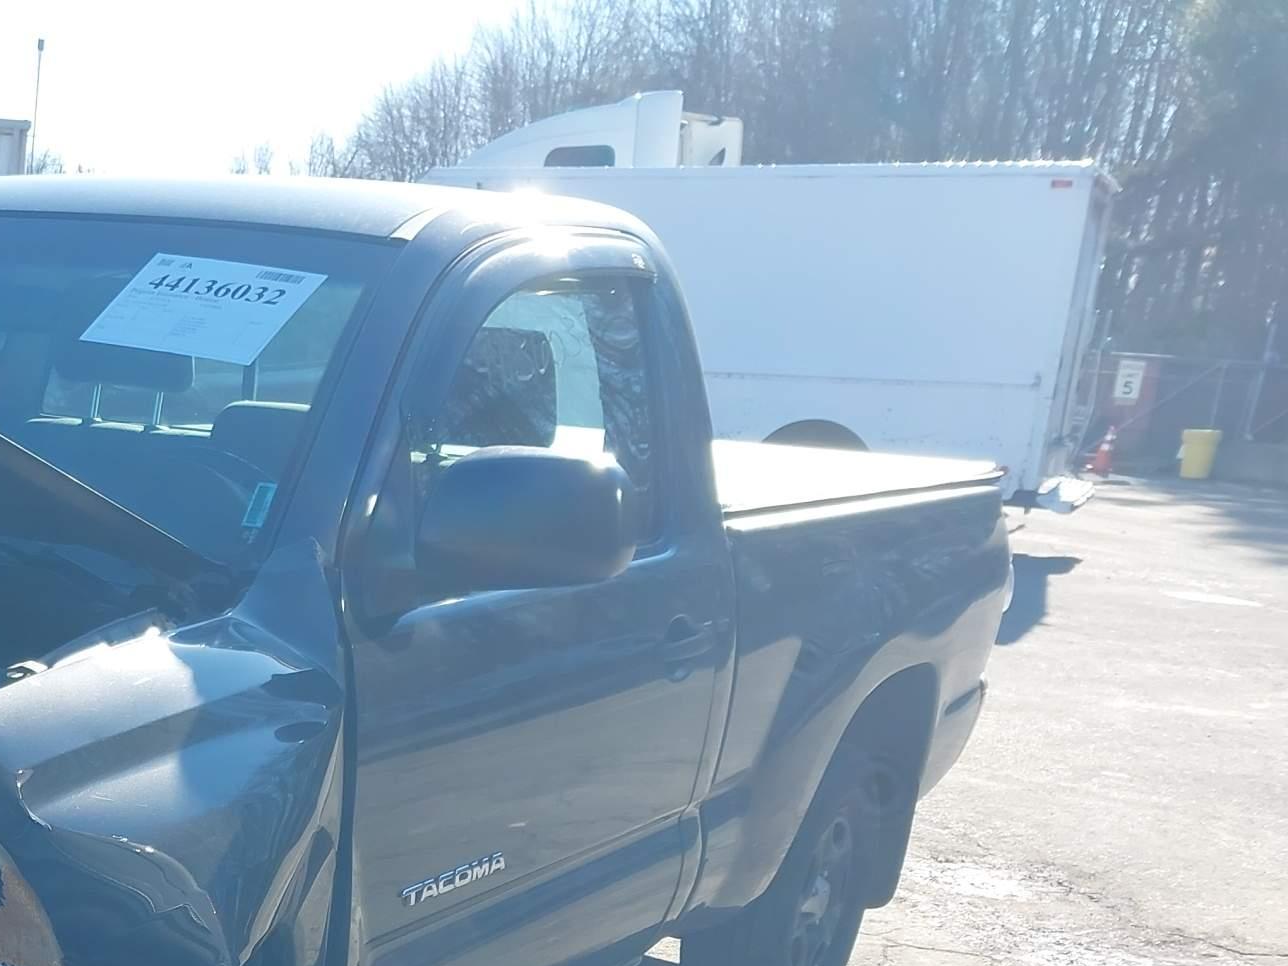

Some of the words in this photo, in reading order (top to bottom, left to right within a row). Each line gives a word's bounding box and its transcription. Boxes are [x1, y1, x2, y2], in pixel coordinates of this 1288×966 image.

[148, 273, 287, 306] 44136032
[1121, 380, 1134, 396] 5
[401, 850, 506, 906] TACOMA
